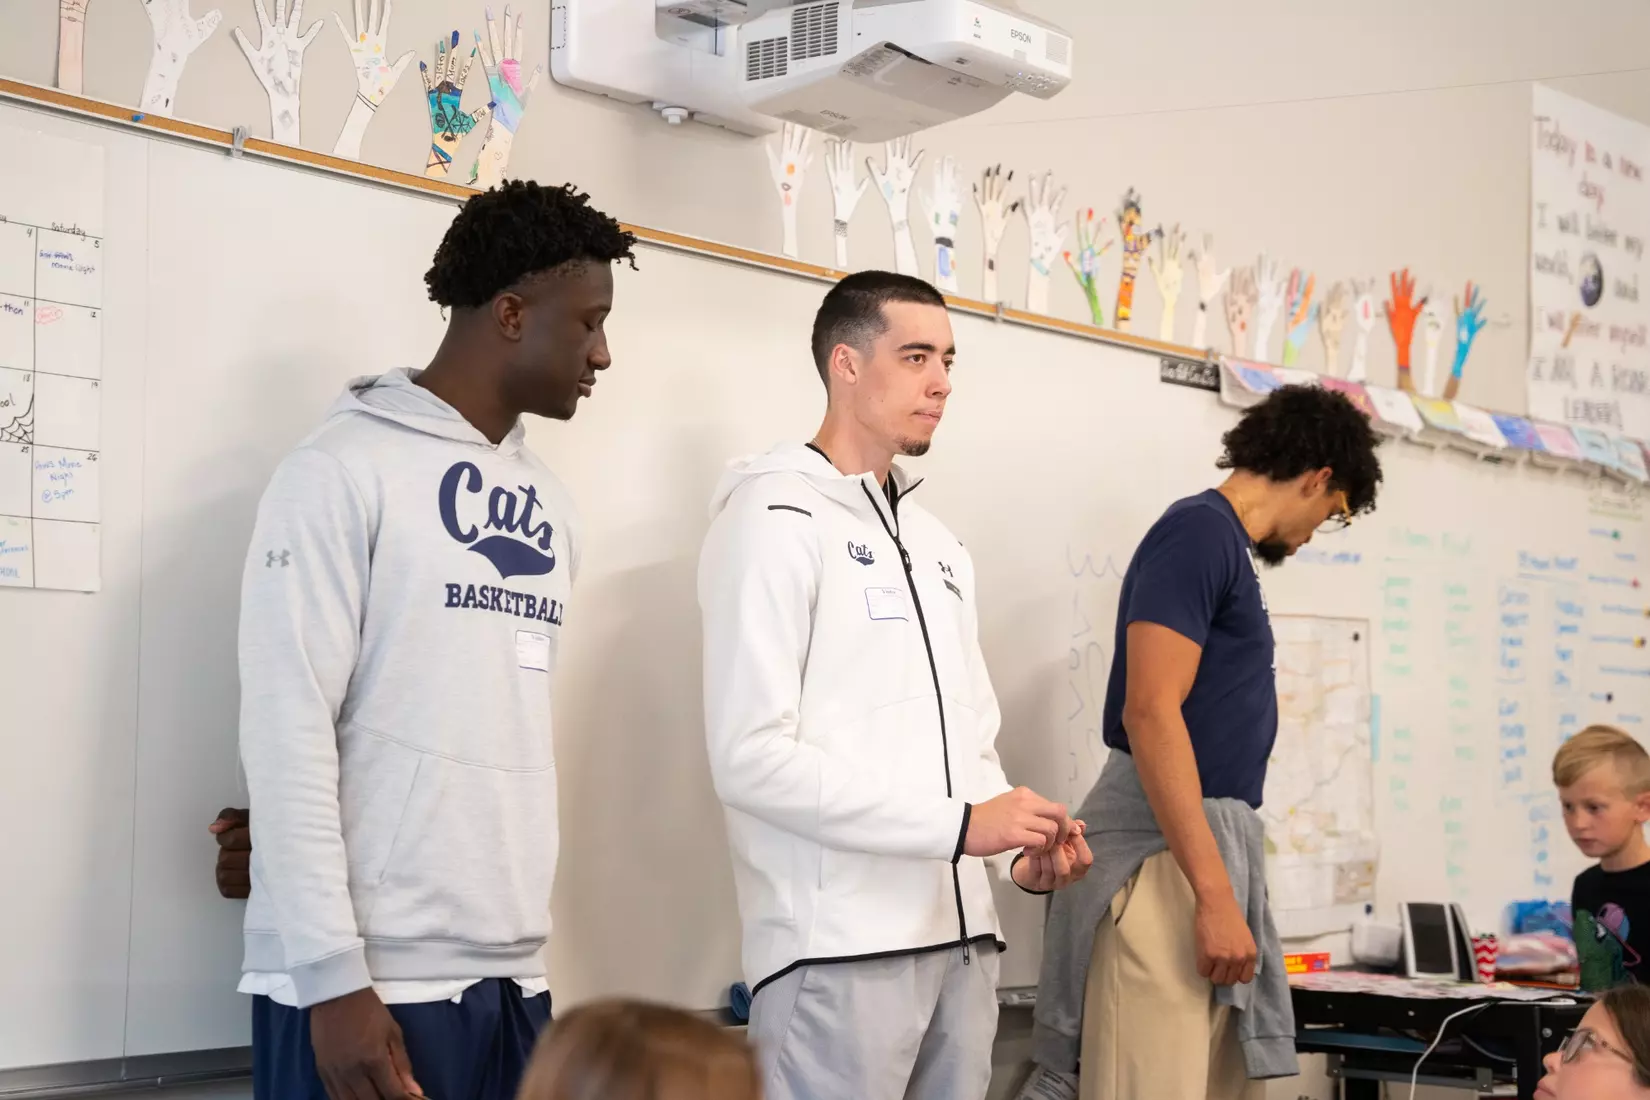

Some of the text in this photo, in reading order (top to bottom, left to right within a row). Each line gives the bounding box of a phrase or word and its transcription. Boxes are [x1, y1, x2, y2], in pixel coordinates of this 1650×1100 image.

[1010, 29, 1032, 44] EPSON
[1533, 116, 1577, 168] Today
[26, 228, 33, 238] 4
[51, 221, 86, 241] Saturday
[94, 239, 100, 248] 5
[21, 445, 30, 453] 25
[86, 453, 98, 461] 26
[438, 461, 554, 551] Cats
[847, 540, 874, 559] Cats
